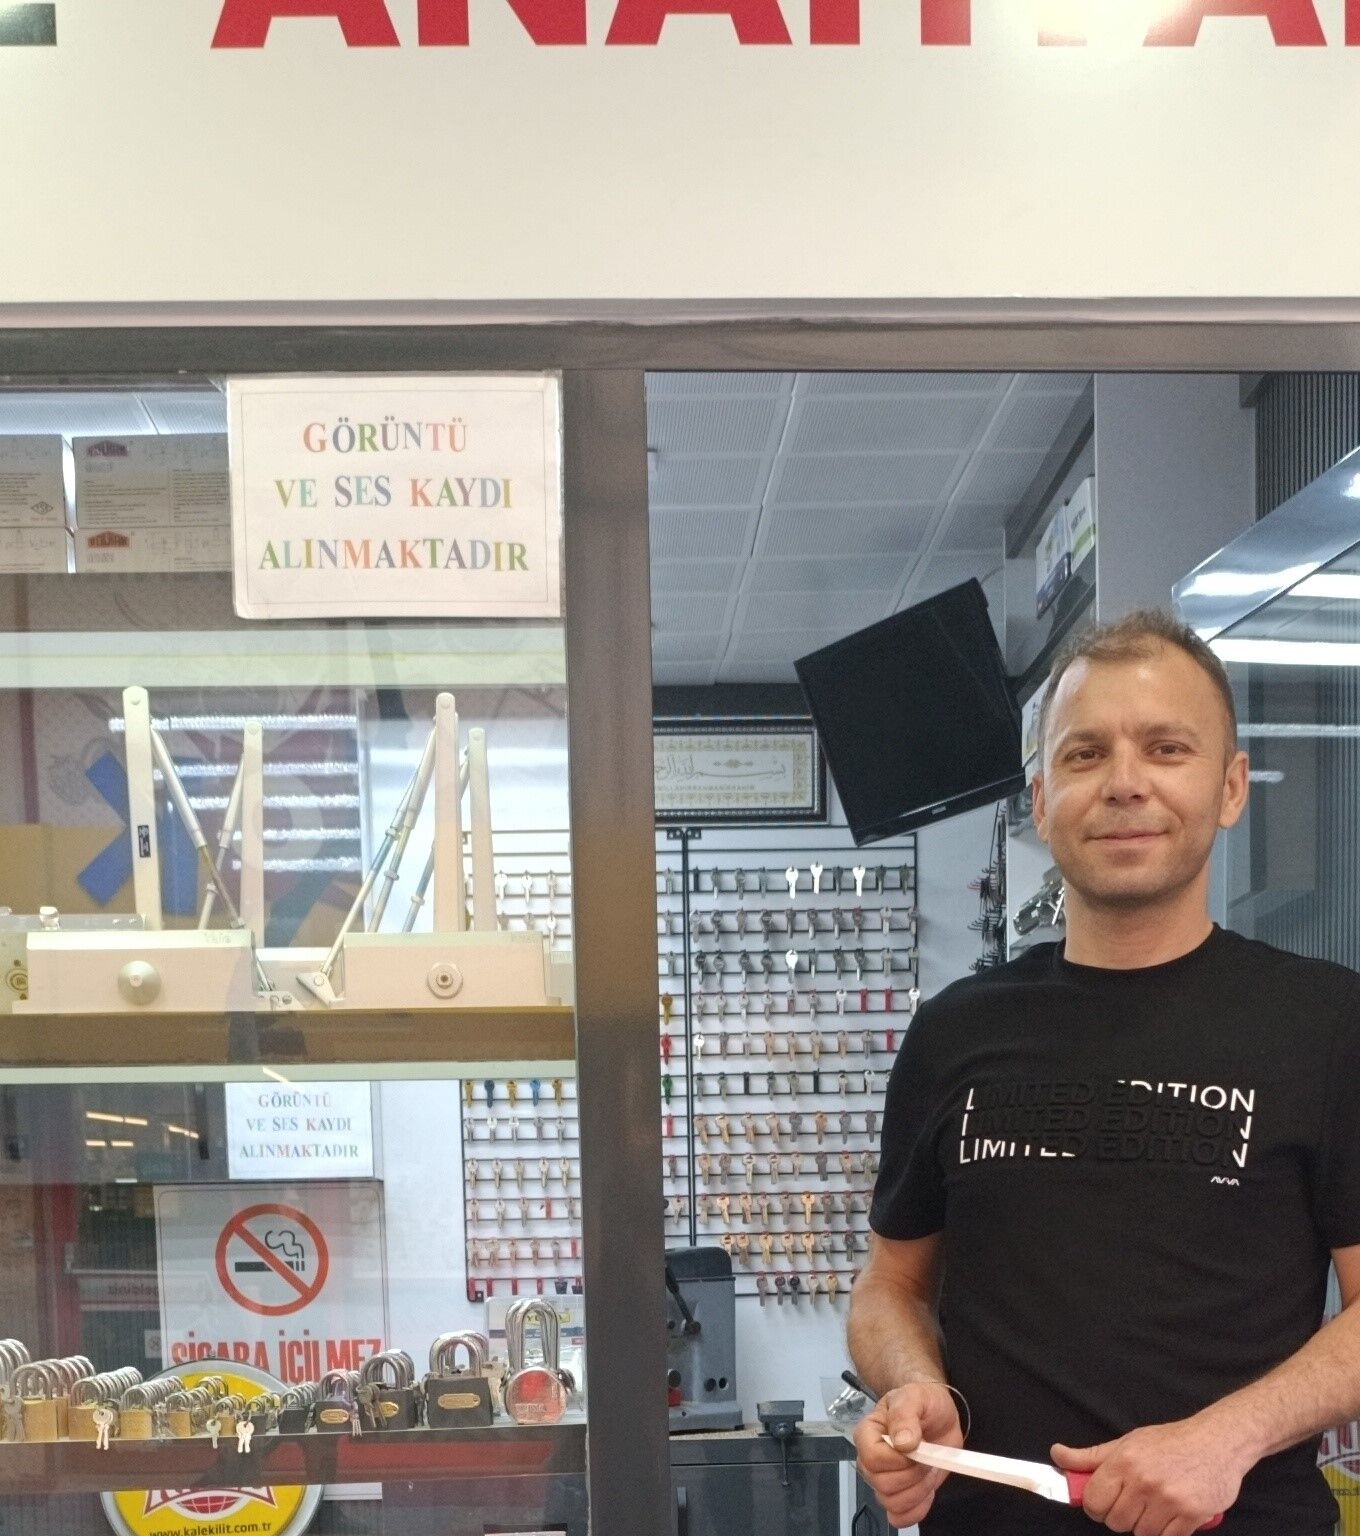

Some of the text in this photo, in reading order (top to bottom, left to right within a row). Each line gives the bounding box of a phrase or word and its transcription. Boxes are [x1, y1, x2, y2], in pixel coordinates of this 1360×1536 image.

[303, 415, 467, 453] GÖRÜNTÜ
[274, 475, 513, 509] VE SES KAYDI
[258, 539, 530, 572] ALINMAKTADIR
[258, 1091, 332, 1108] GÖRÜNTÜ
[246, 1117, 352, 1132] VE SES KAYDI
[240, 1143, 360, 1159] ALINMAKTADIR
